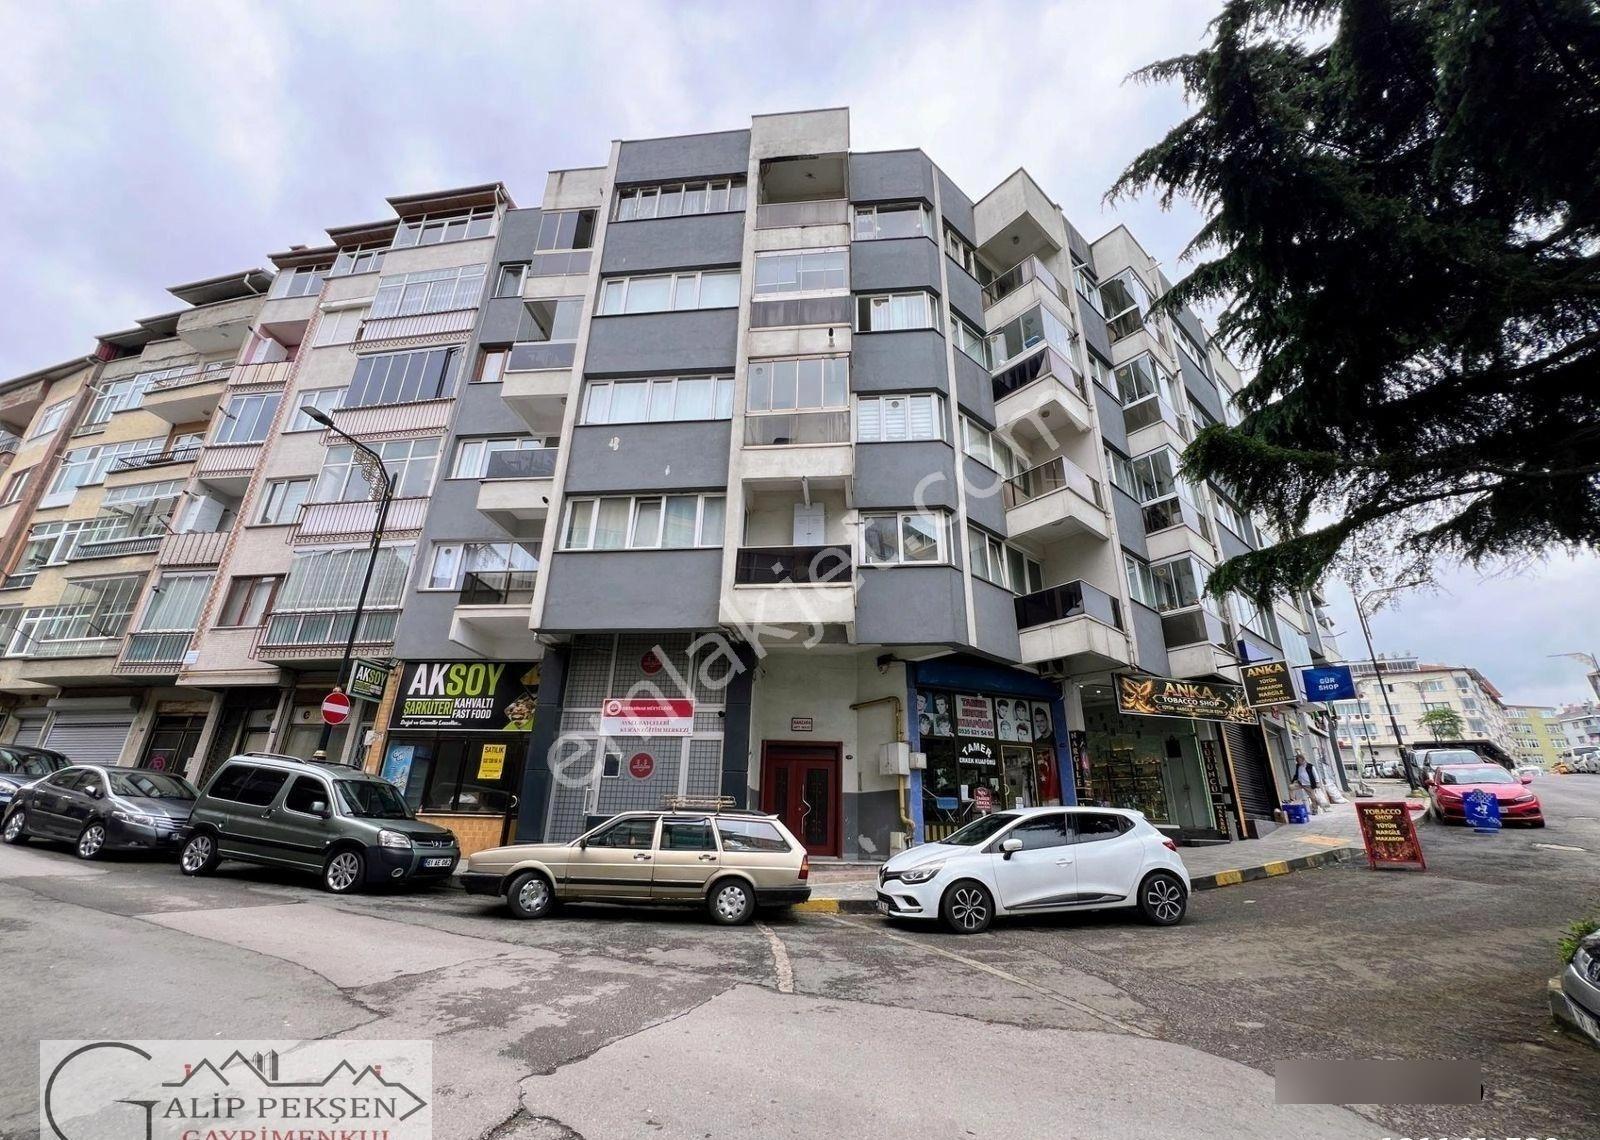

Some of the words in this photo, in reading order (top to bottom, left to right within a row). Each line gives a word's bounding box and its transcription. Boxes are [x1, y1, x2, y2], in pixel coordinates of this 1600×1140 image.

[356, 665, 387, 687] AKSOY
[1247, 663, 1285, 677] ANKA
[407, 663, 506, 696] AKSOY
[1163, 682, 1215, 699] ANKA
[454, 698, 493, 709] KAHVALTI
[1163, 696, 1198, 706] TOBACCO
[1199, 699, 1220, 707] SHOP
[452, 709, 469, 719] FAST
[471, 709, 491, 719] FOOD
[484, 746, 504, 754] SATILIK
[962, 742, 992, 758] TAMER
